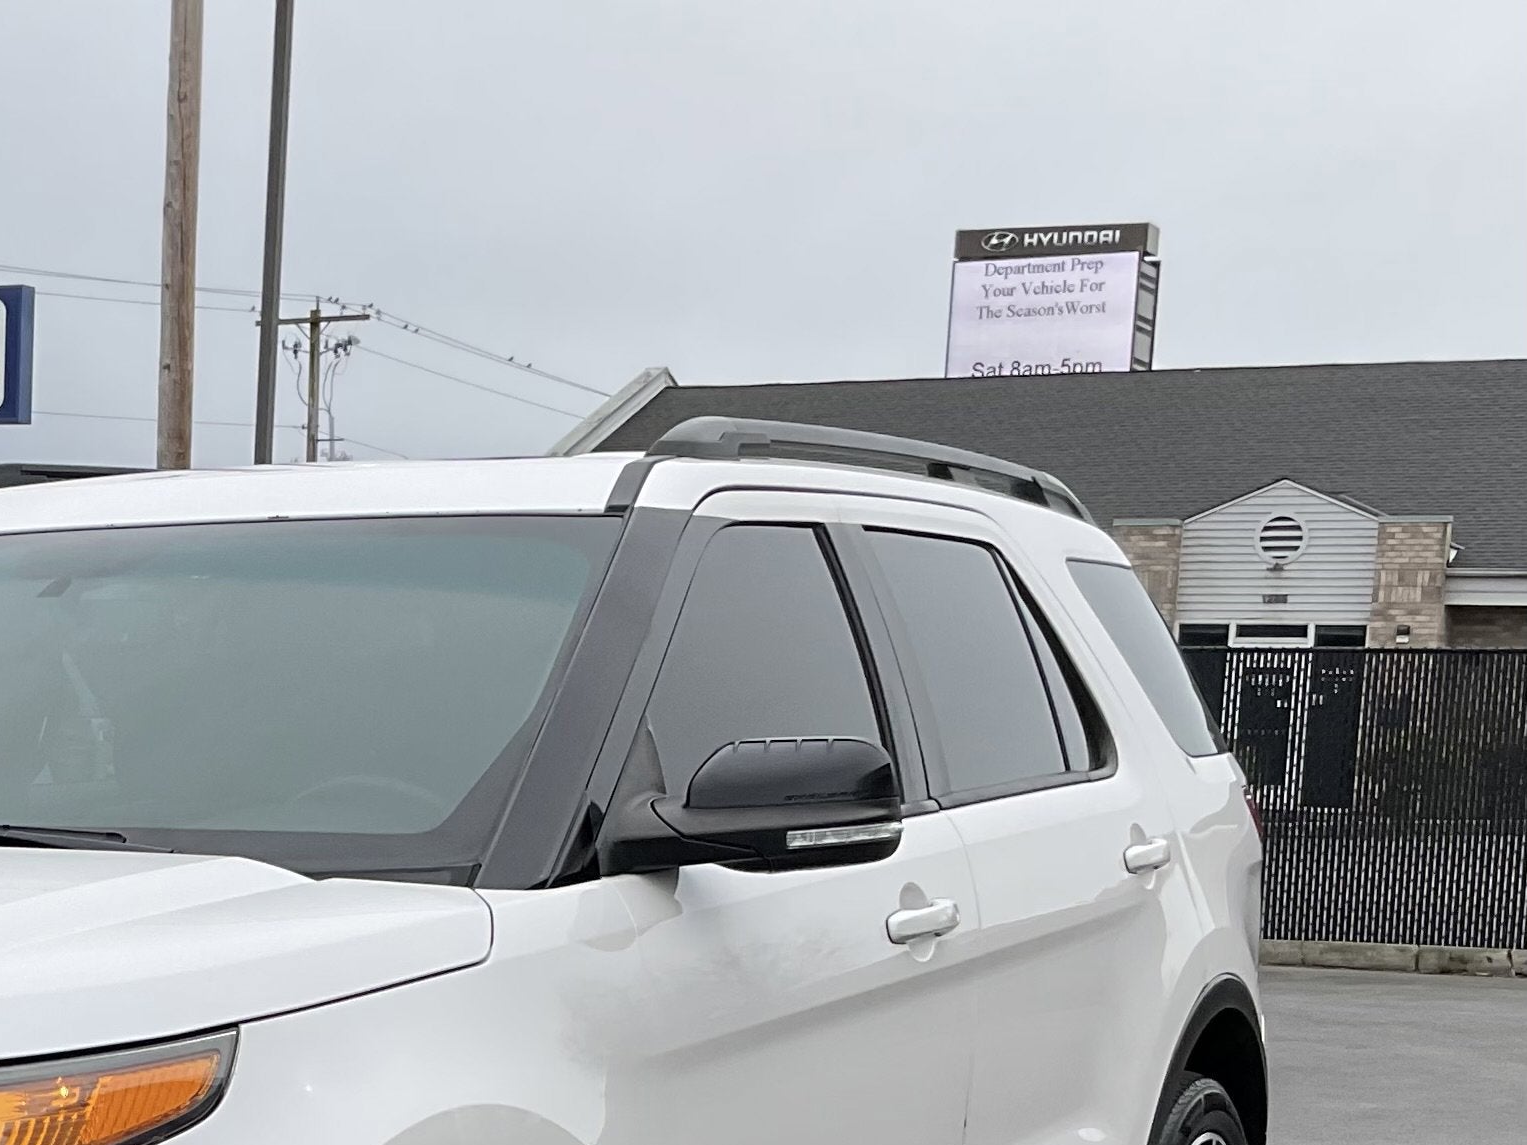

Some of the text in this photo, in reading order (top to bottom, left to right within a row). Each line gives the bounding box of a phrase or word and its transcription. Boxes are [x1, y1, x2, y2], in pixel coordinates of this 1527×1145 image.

[1023, 229, 1121, 247] HYUNDAI
[983, 257, 1104, 280] Department Prep
[981, 278, 1106, 299] Your Vehicle For
[976, 305, 1003, 320] The
[1064, 300, 1107, 315] Worst
[971, 361, 1004, 377] Sat
